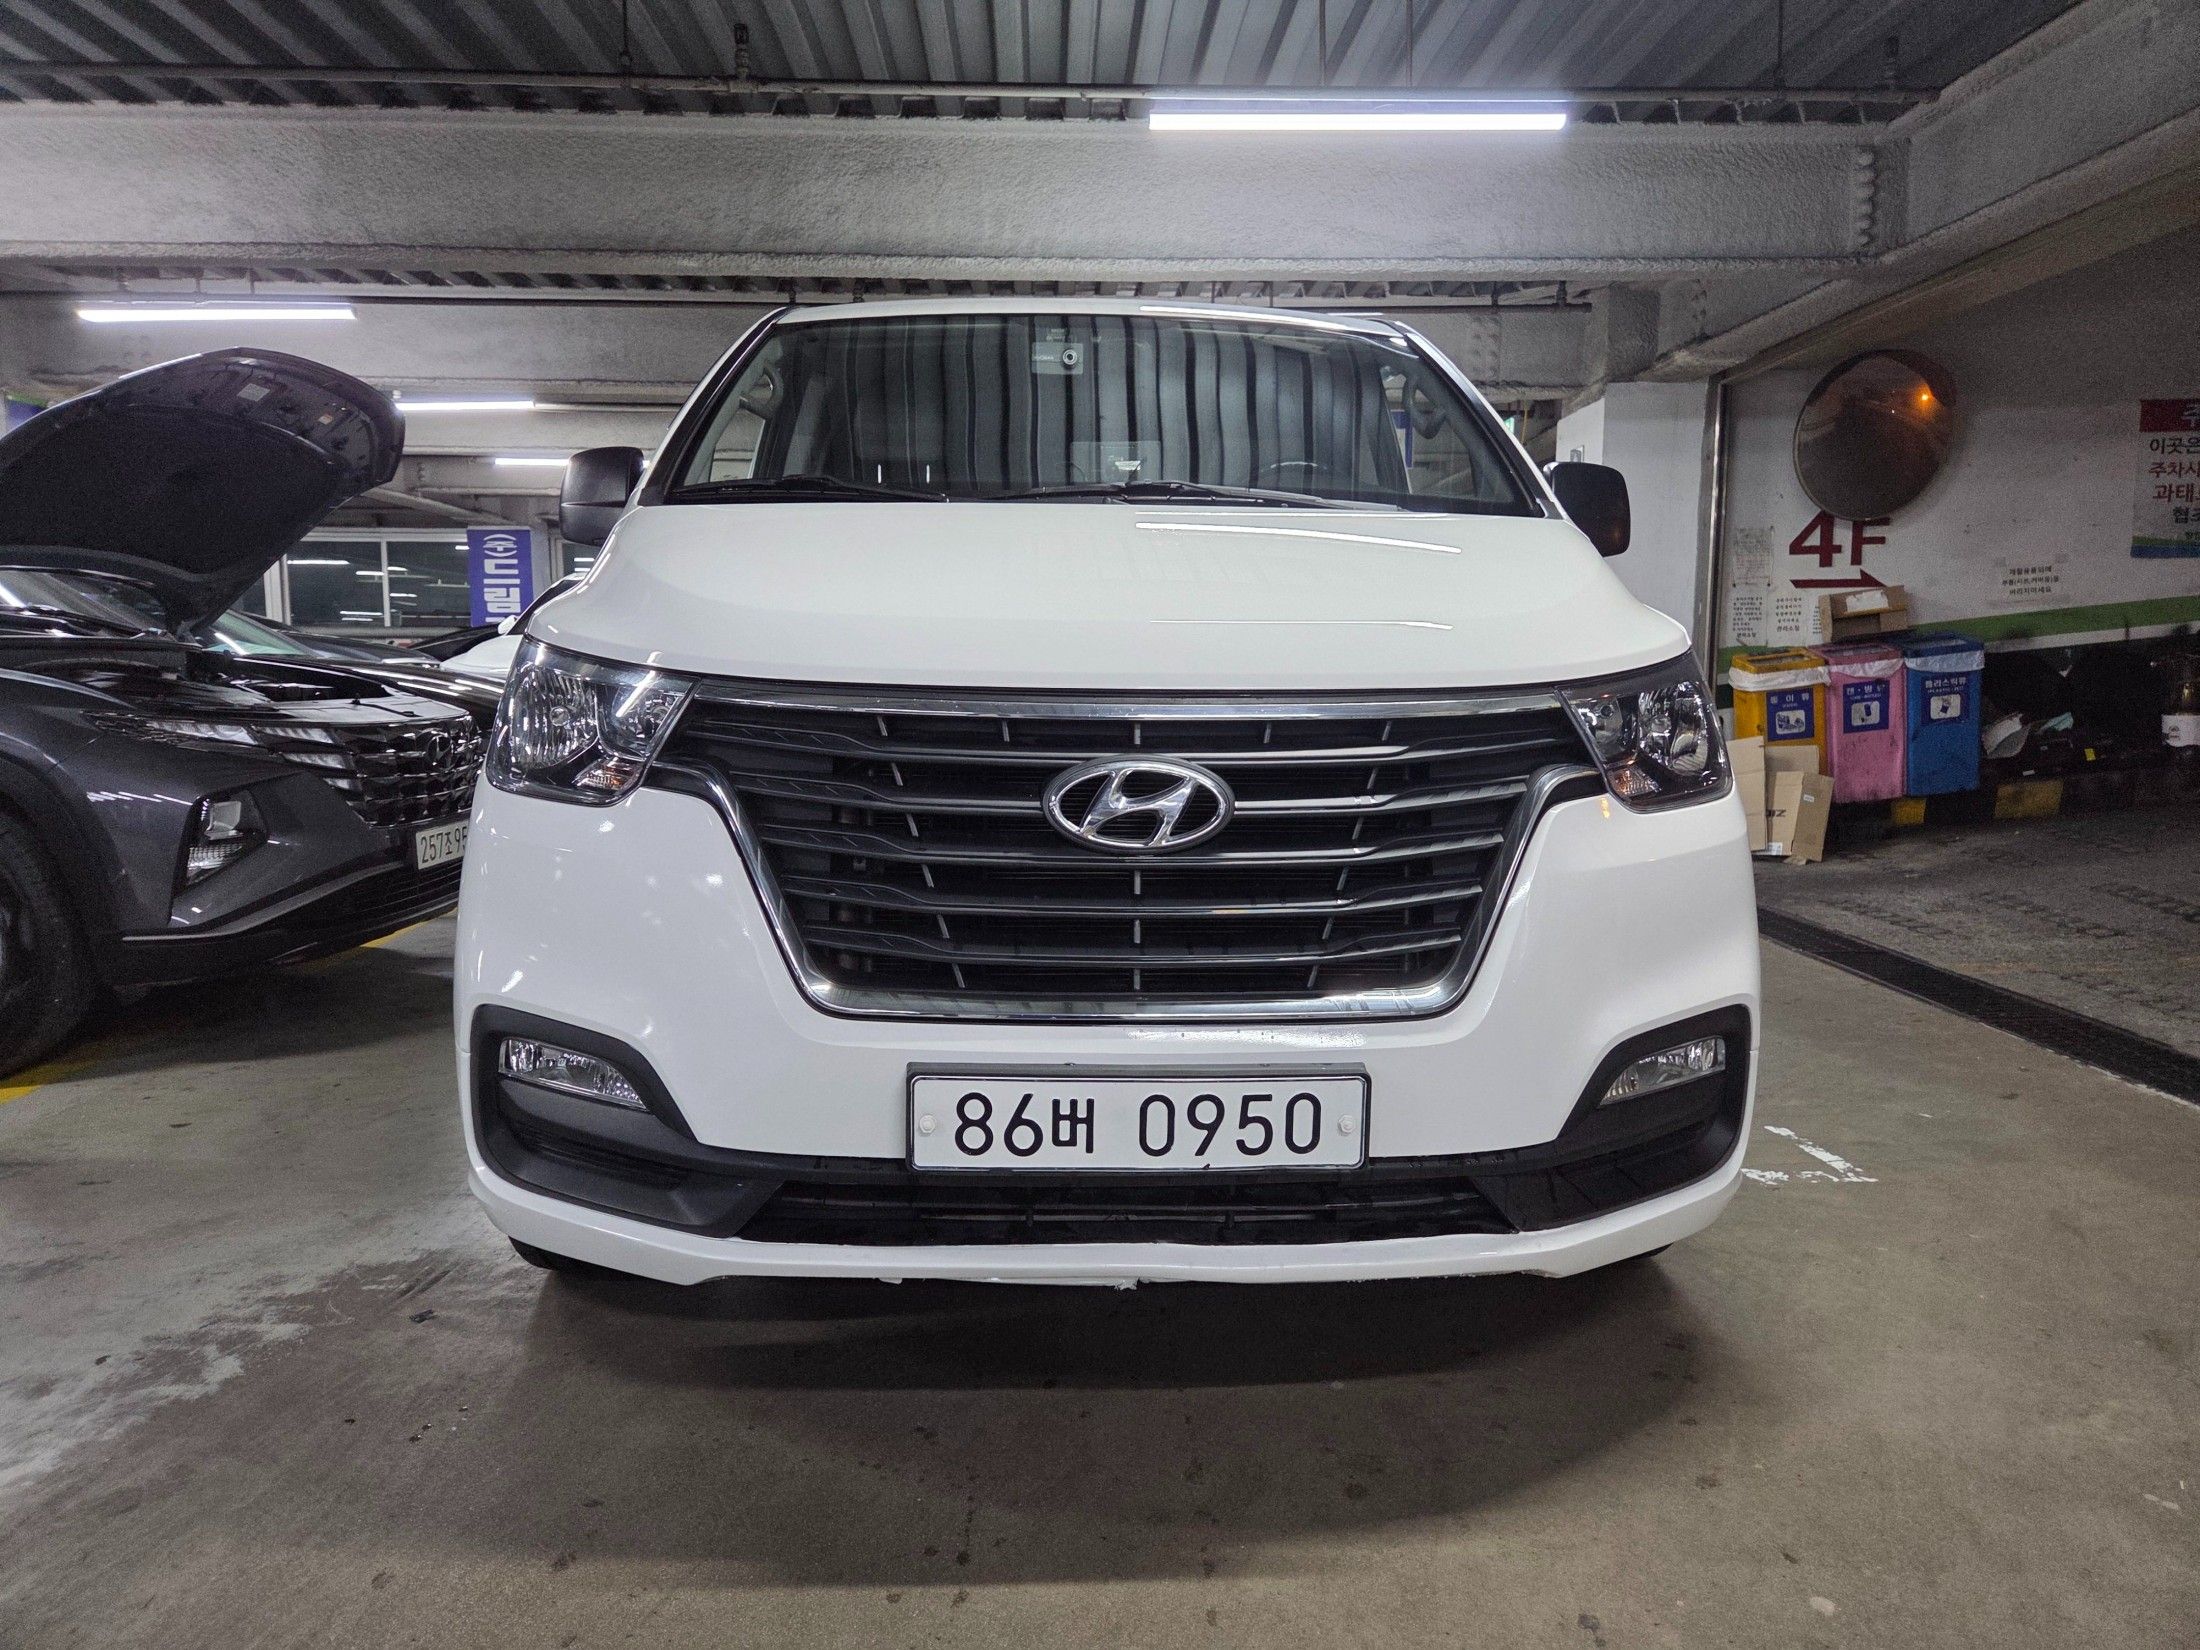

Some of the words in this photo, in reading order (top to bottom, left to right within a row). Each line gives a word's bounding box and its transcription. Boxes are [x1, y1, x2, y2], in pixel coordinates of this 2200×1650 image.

[2152, 482, 2200, 502] 과태
[1789, 510, 1890, 567] 4F
[954, 1092, 1095, 1157] 86버
[1139, 1092, 1323, 1157] 0950
